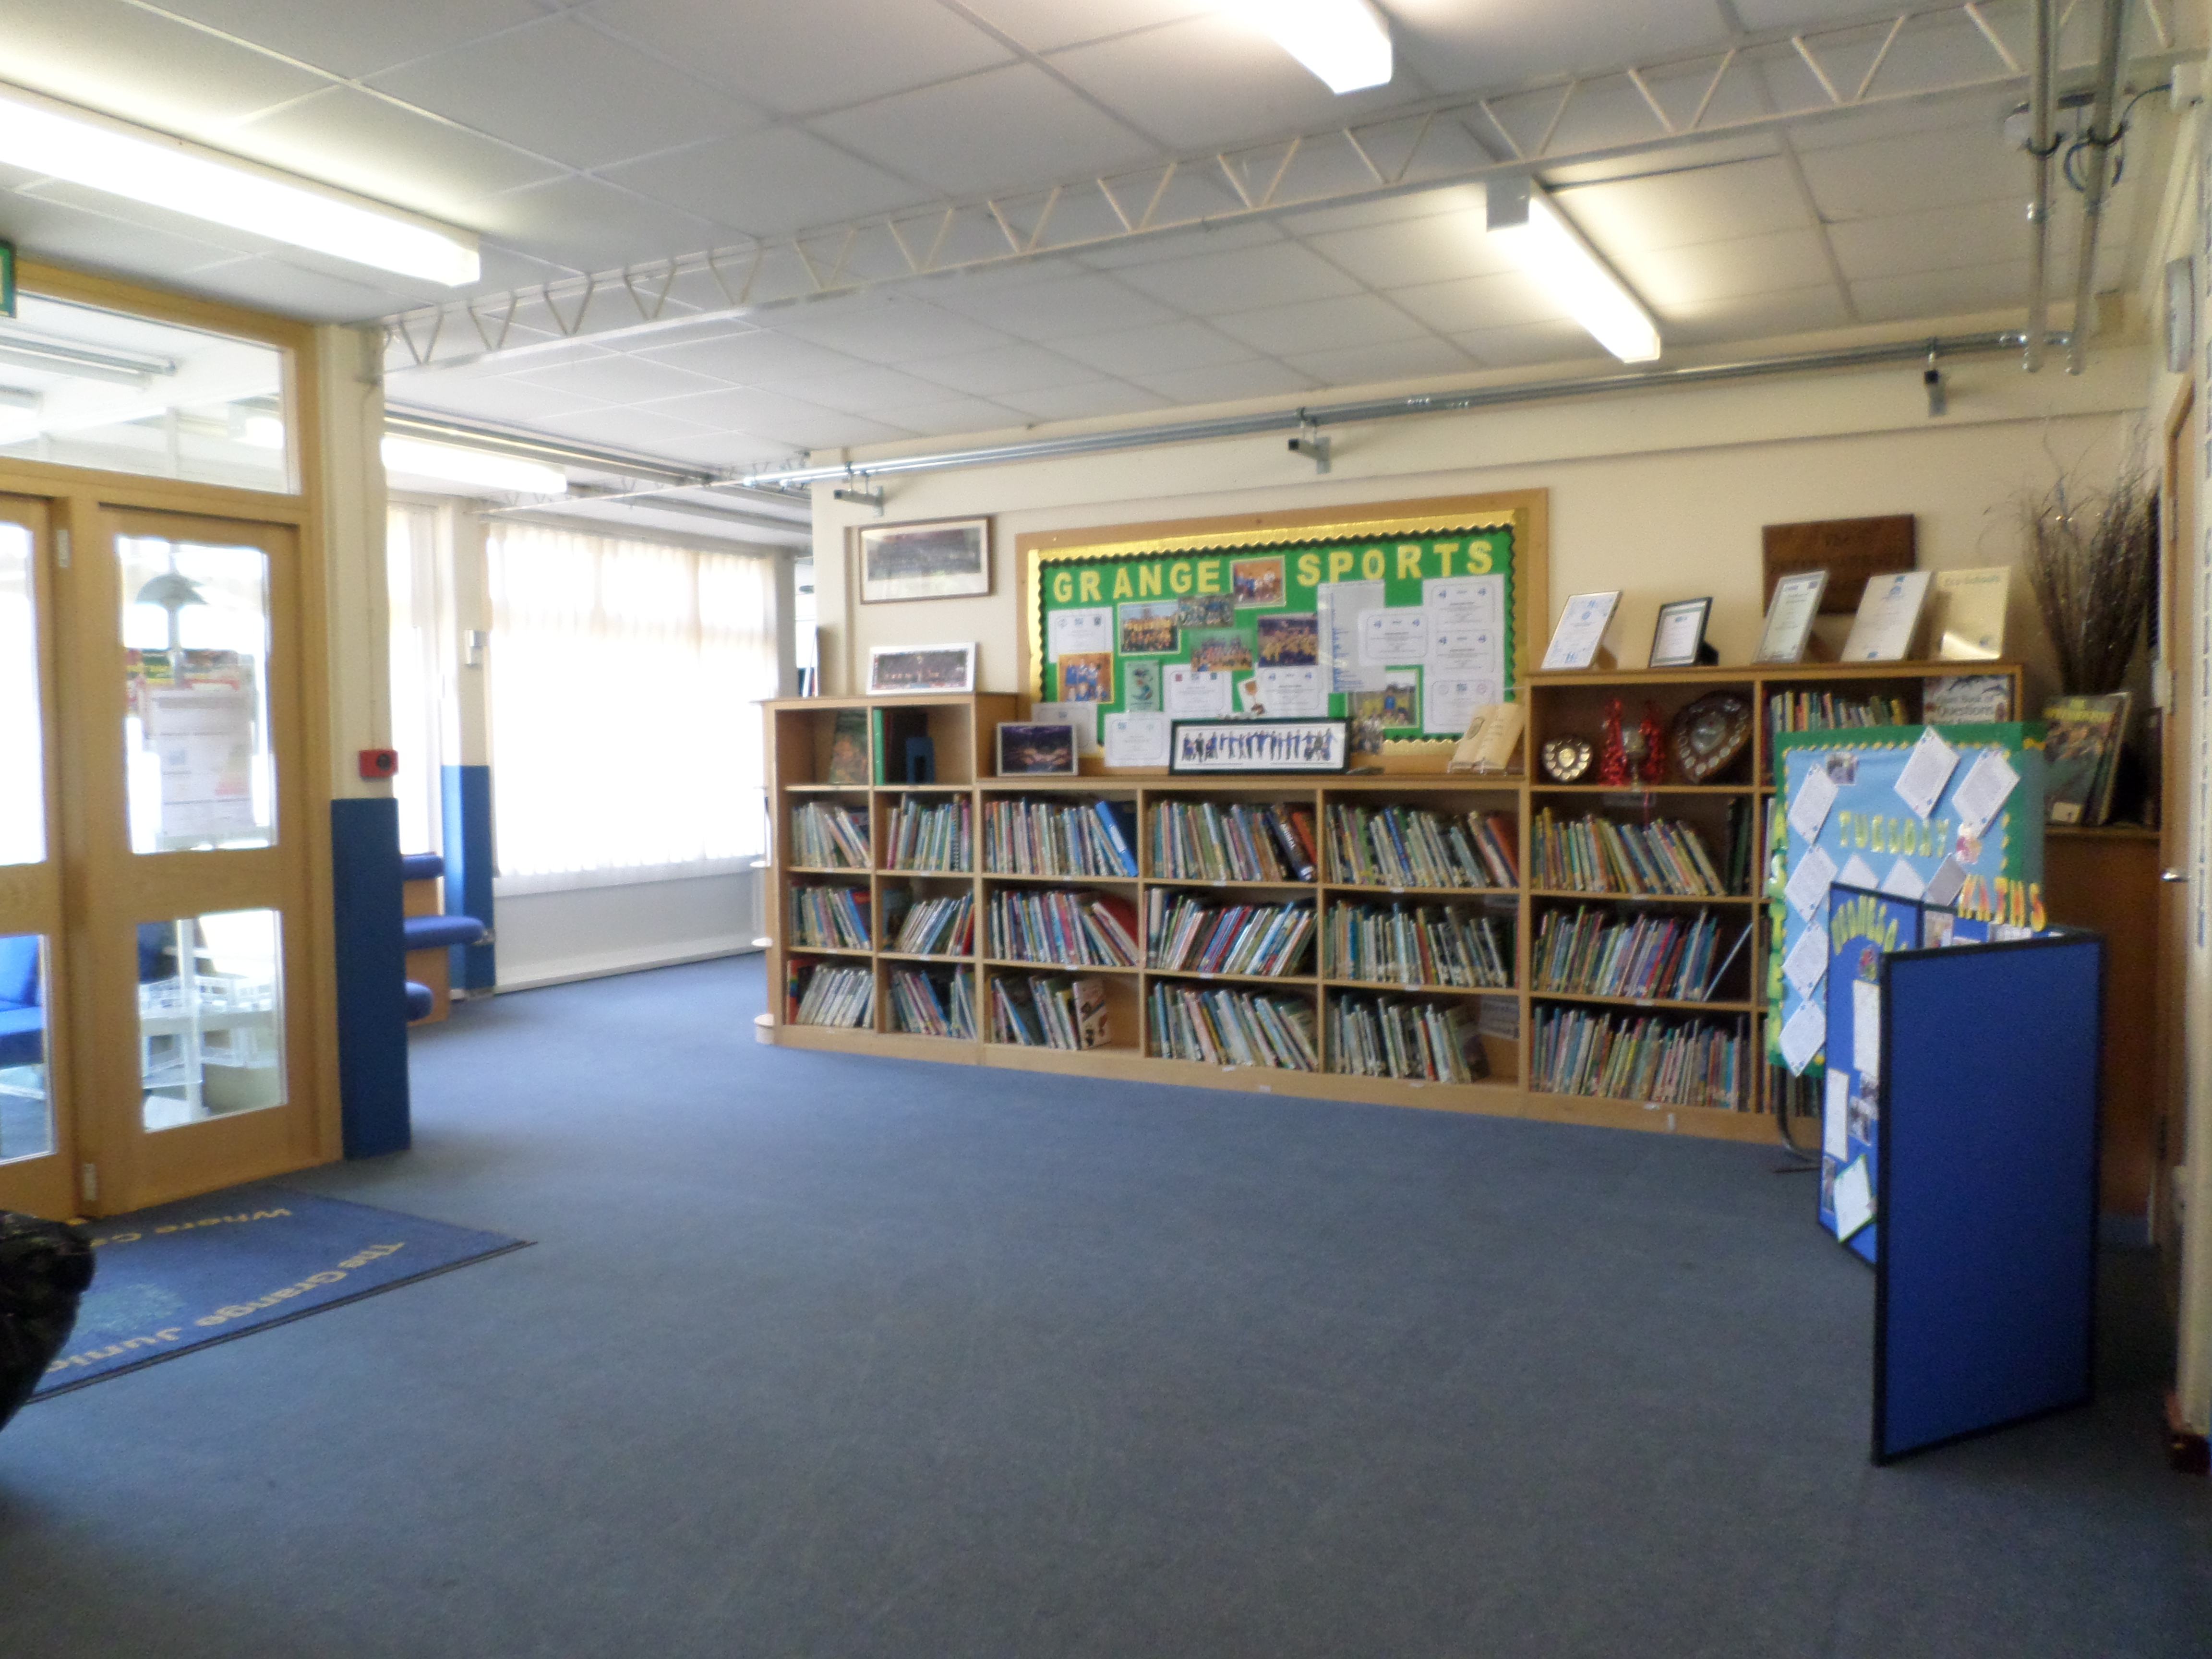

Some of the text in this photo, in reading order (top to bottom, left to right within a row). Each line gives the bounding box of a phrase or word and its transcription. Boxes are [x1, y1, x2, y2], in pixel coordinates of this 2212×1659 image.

[1053, 540, 1493, 603] GRANGE SPORTS
[194, 1271, 347, 1326] Grange
[46, 1327, 182, 1372] Junio
